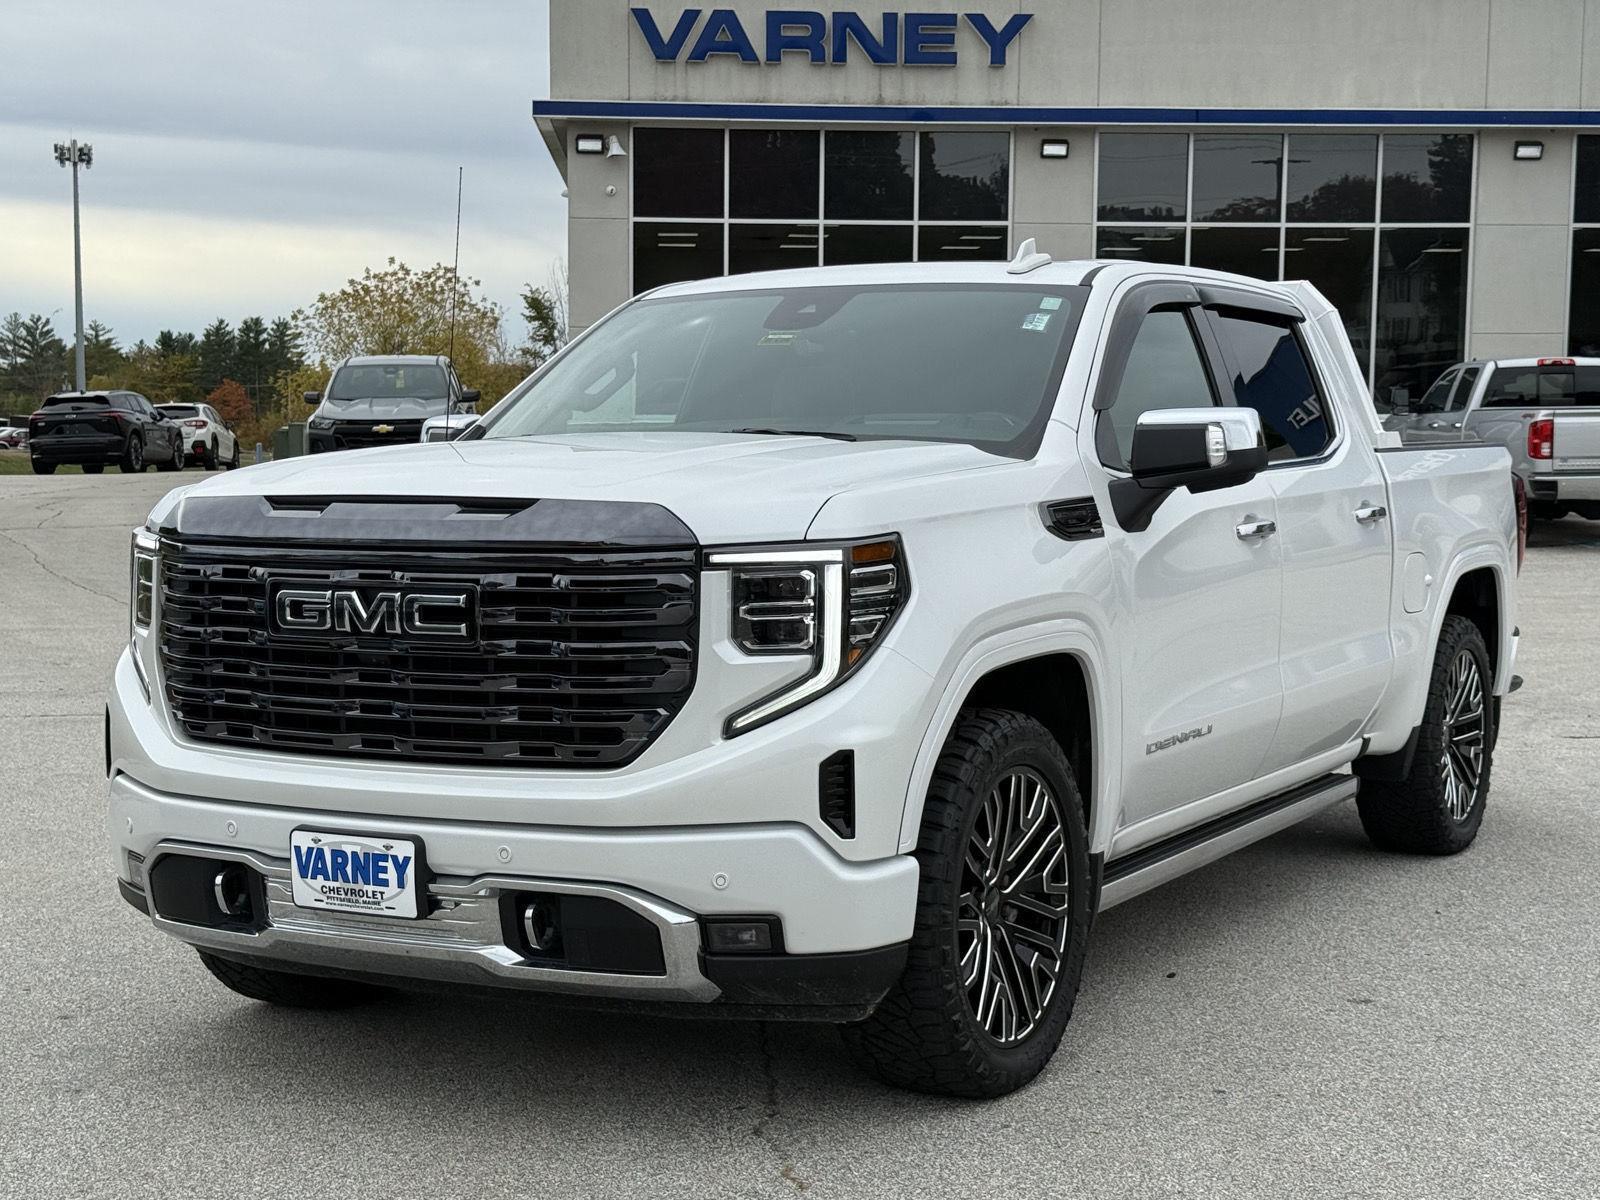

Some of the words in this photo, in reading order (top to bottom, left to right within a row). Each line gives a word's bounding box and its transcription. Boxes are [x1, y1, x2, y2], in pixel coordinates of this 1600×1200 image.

[630, 7, 1034, 66] VARNEY
[276, 590, 467, 637] GMC
[1145, 724, 1213, 755] DENALI
[294, 845, 411, 889] VARNEY
[320, 884, 386, 900] CHEVROLET
